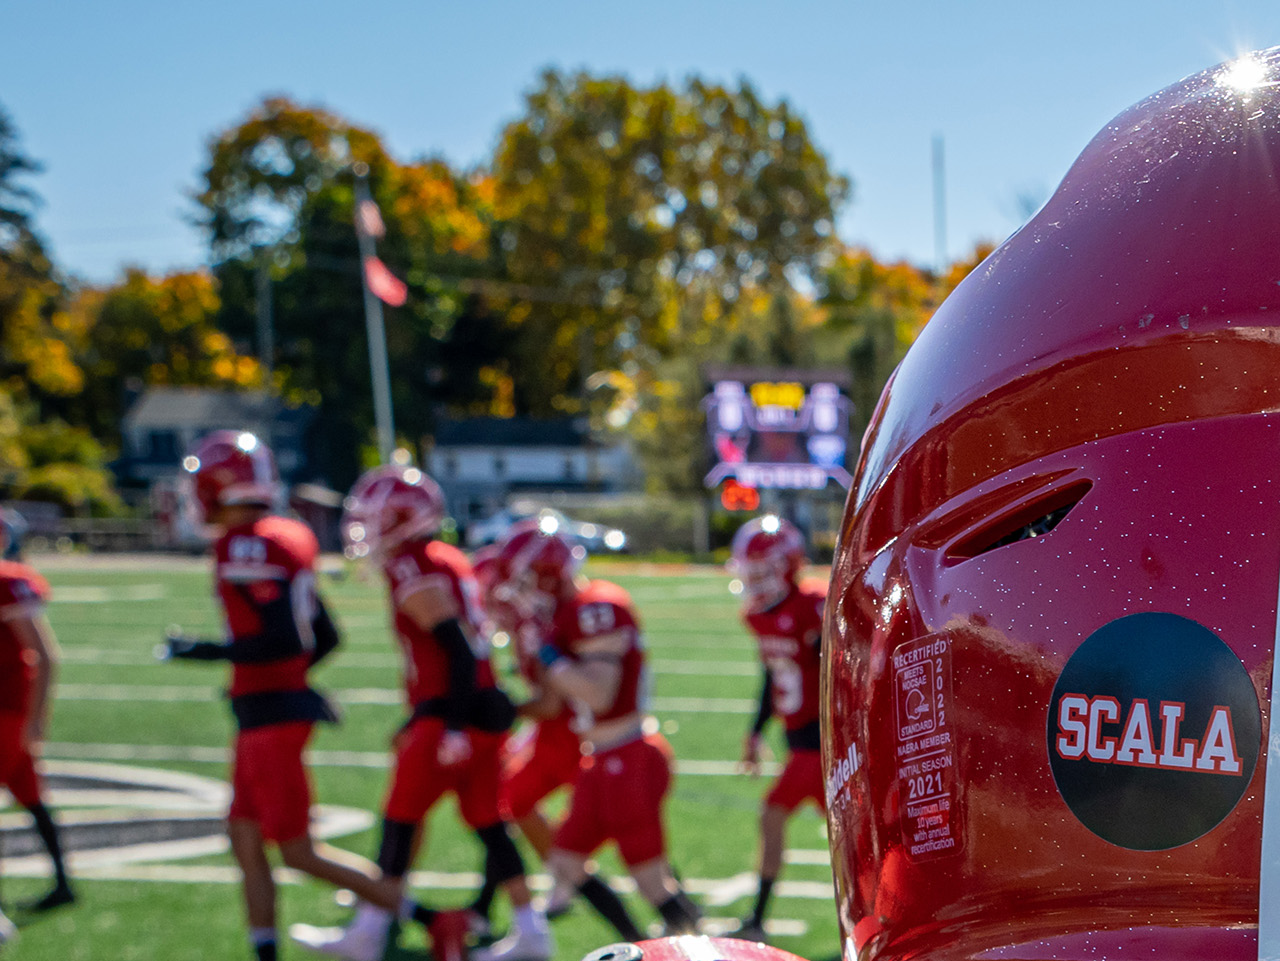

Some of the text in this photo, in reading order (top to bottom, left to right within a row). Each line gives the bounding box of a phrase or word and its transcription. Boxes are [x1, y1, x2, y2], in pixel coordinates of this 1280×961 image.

[894, 640, 946, 669] RECERTIFIED
[904, 666, 924, 680] MEETS
[902, 675, 927, 691] NOCSAE
[901, 720, 933, 736] STANDARD
[1056, 693, 1243, 776] SCALA
[920, 732, 950, 749] MEMBER
[899, 755, 952, 779] INITIAL SEASON
[909, 772, 942, 799] 2021
[907, 799, 950, 818] Maximum life
[917, 815, 942, 829] 10 years
[914, 824, 950, 842] with annual
[911, 837, 955, 855] recertification
